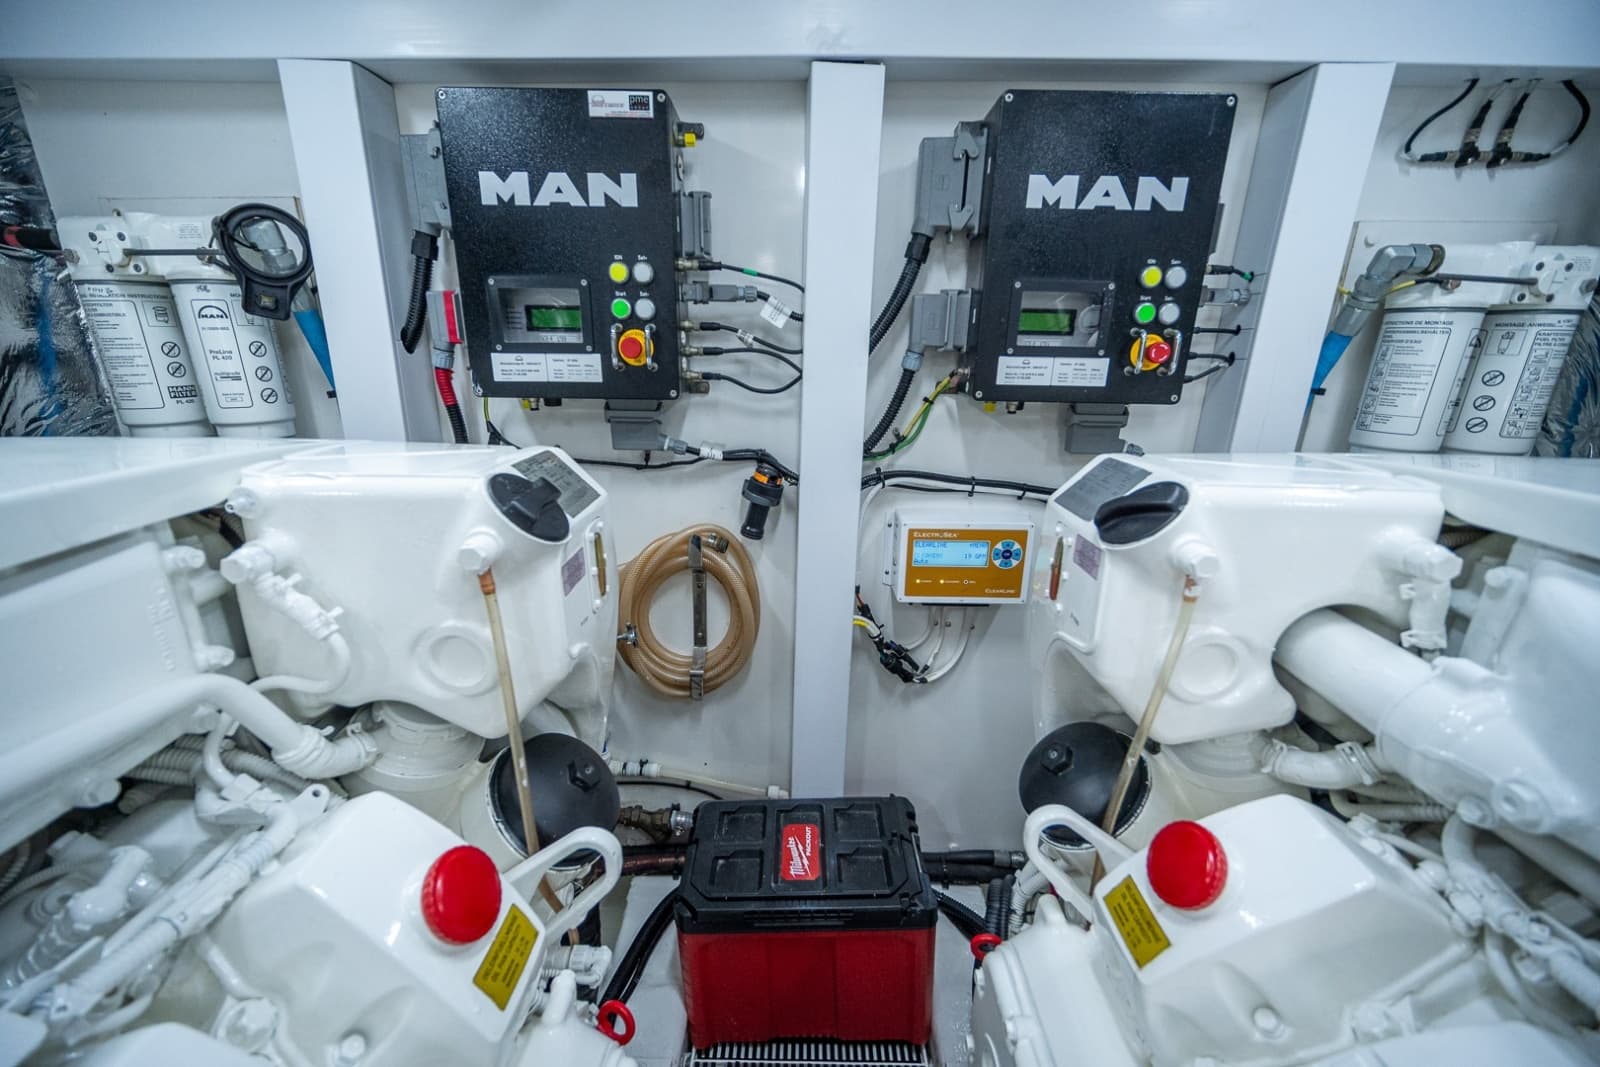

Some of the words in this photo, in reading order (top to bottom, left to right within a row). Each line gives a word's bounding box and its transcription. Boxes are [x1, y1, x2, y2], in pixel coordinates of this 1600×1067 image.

[478, 171, 639, 208] MAN
[1025, 174, 1190, 212] MAN
[787, 836, 806, 878] Milwaukee
